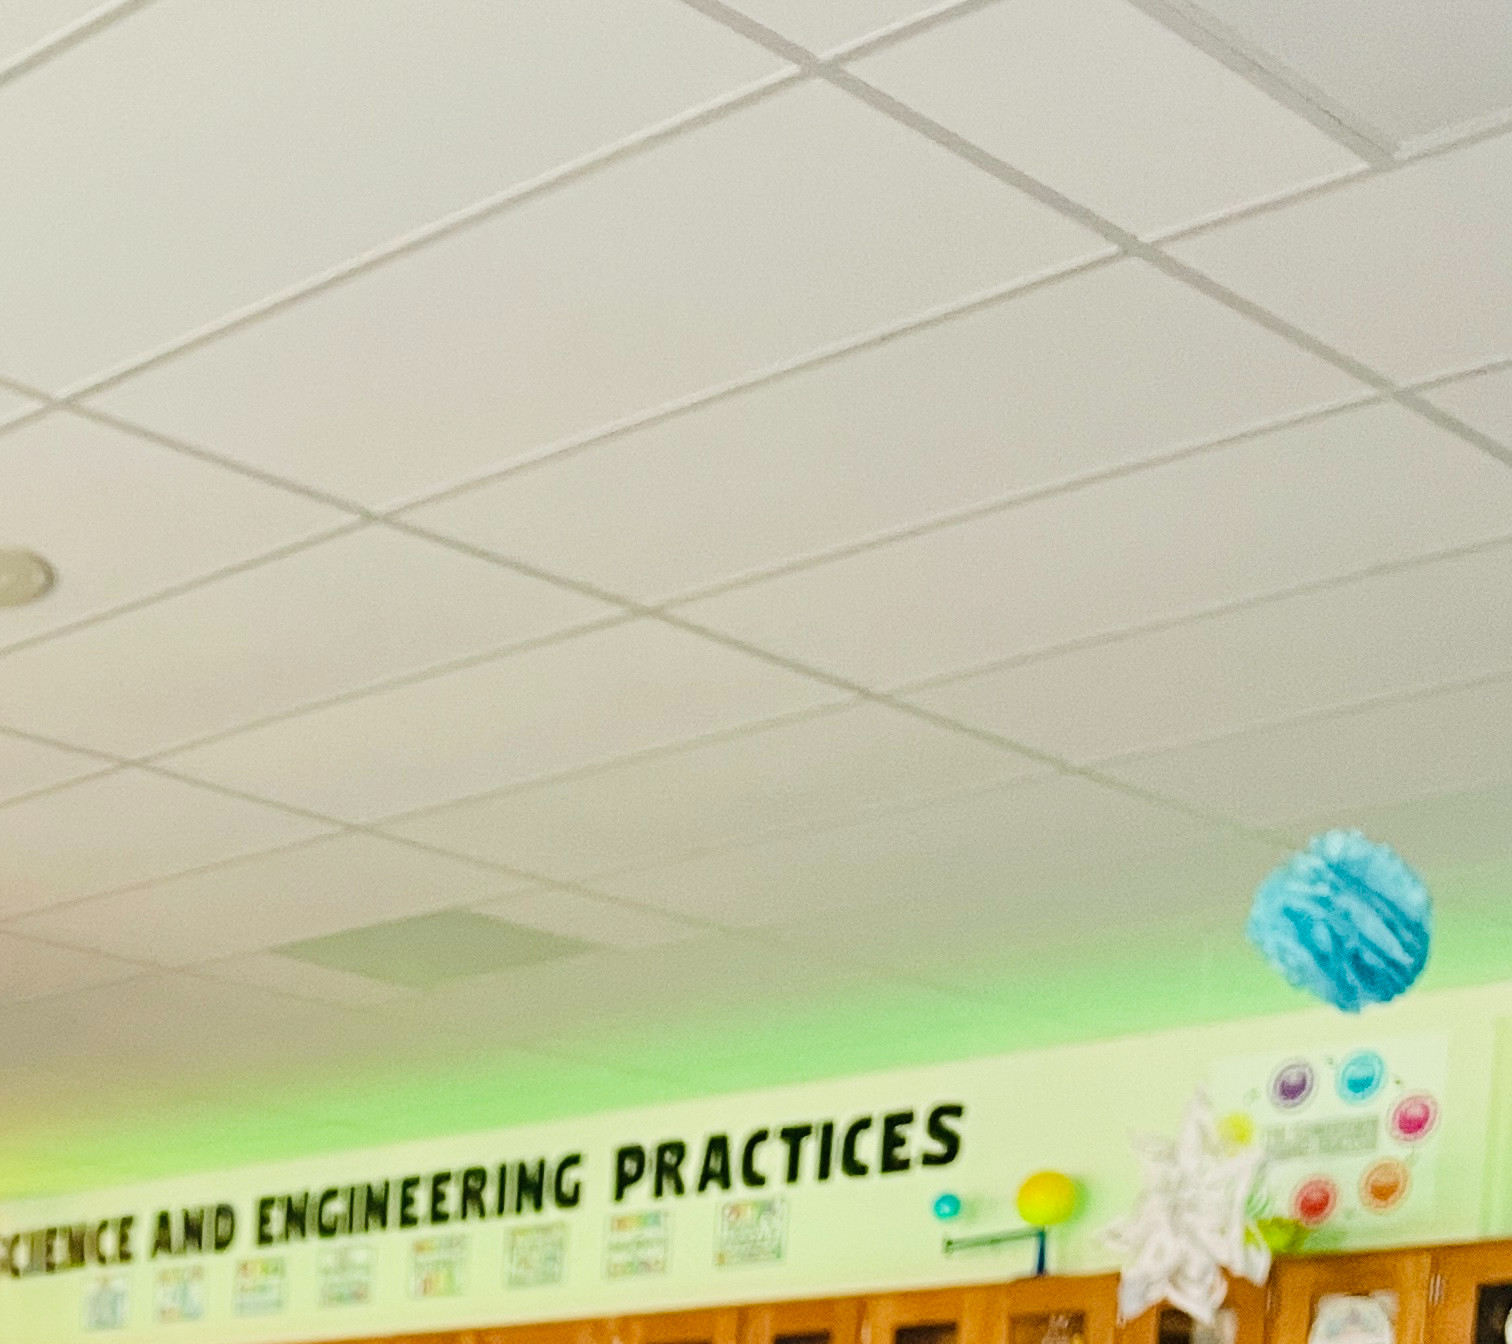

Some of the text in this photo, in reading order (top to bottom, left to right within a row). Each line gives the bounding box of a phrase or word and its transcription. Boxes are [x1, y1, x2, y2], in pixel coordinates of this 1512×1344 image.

[151, 1202, 235, 1259] AND
[257, 1152, 583, 1245] ENGINEERING
[613, 1103, 964, 1202] PRACTICES
